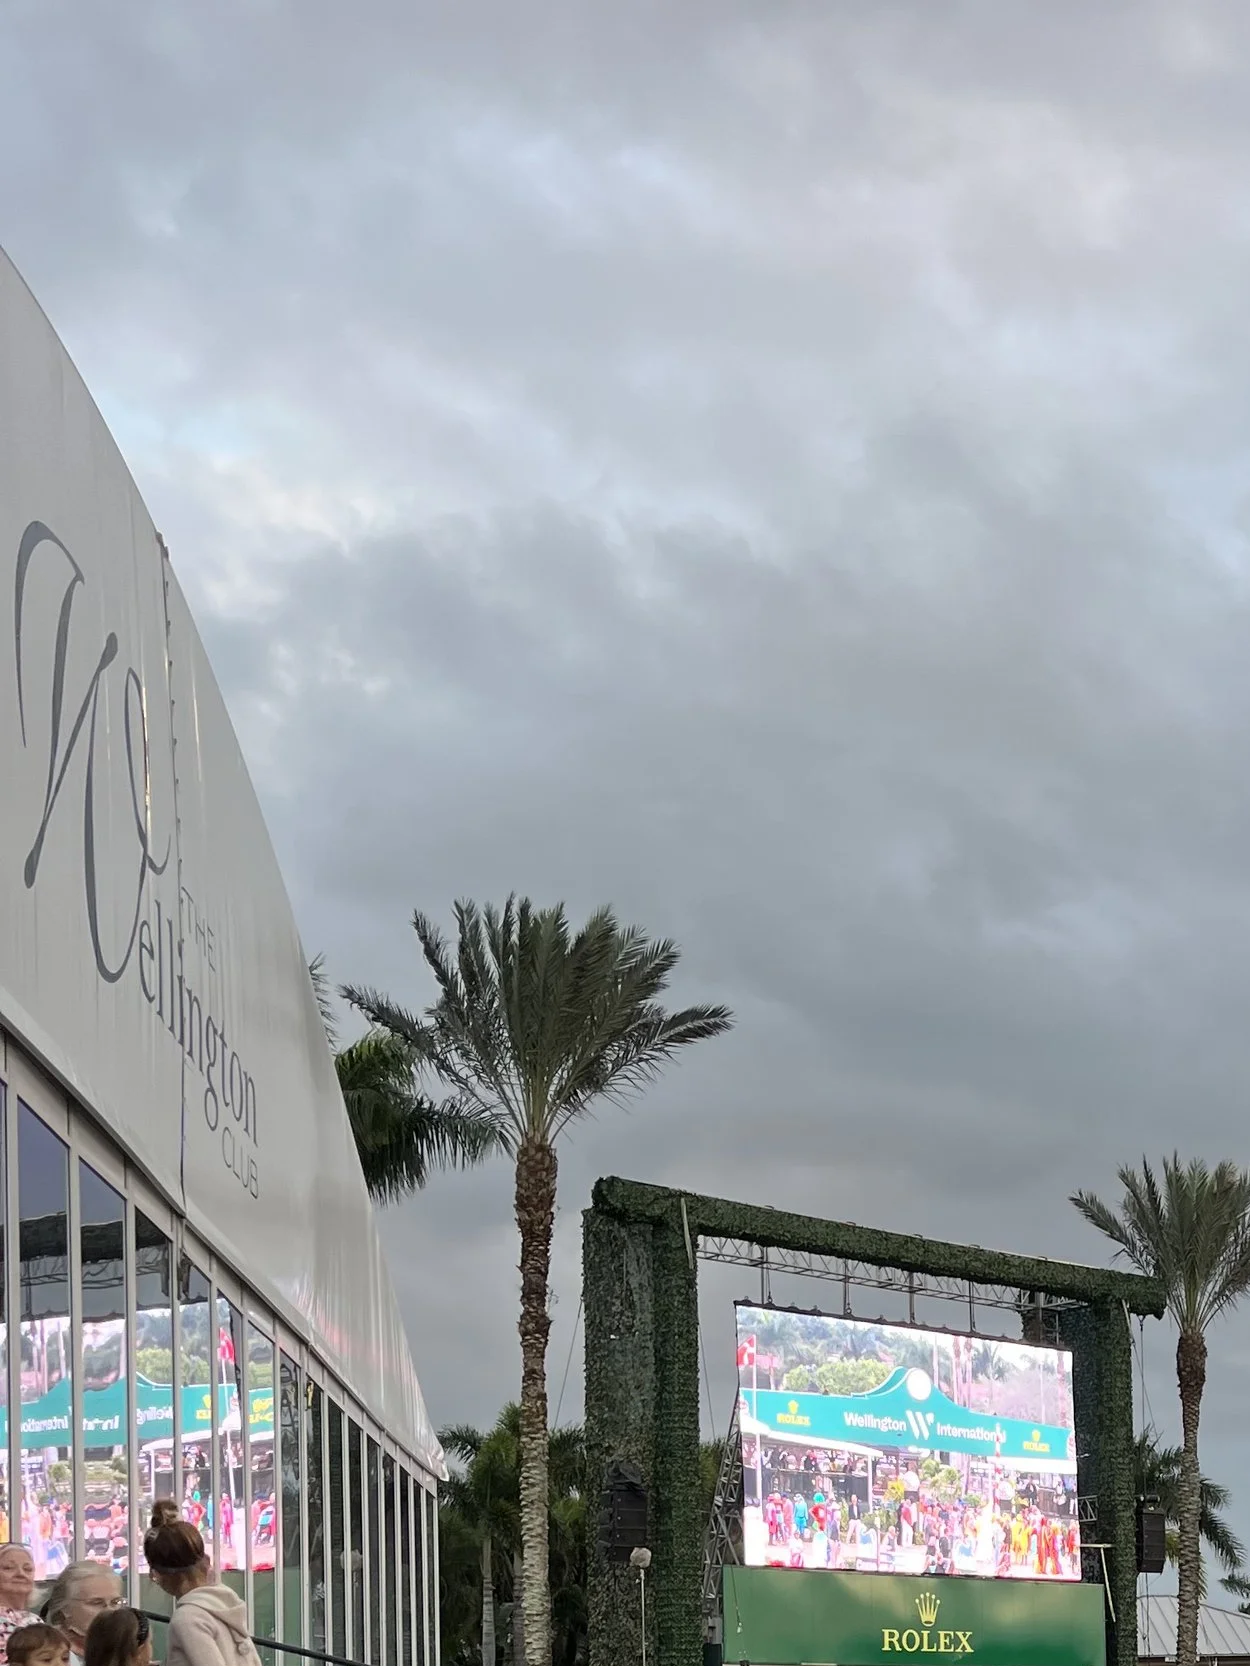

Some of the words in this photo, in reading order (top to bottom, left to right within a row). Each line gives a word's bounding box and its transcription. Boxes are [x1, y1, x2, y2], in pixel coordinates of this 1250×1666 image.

[221, 1126, 258, 1199] CLUB
[844, 1411, 907, 1432] Wellington
[882, 1629, 974, 1653] ROLEX
